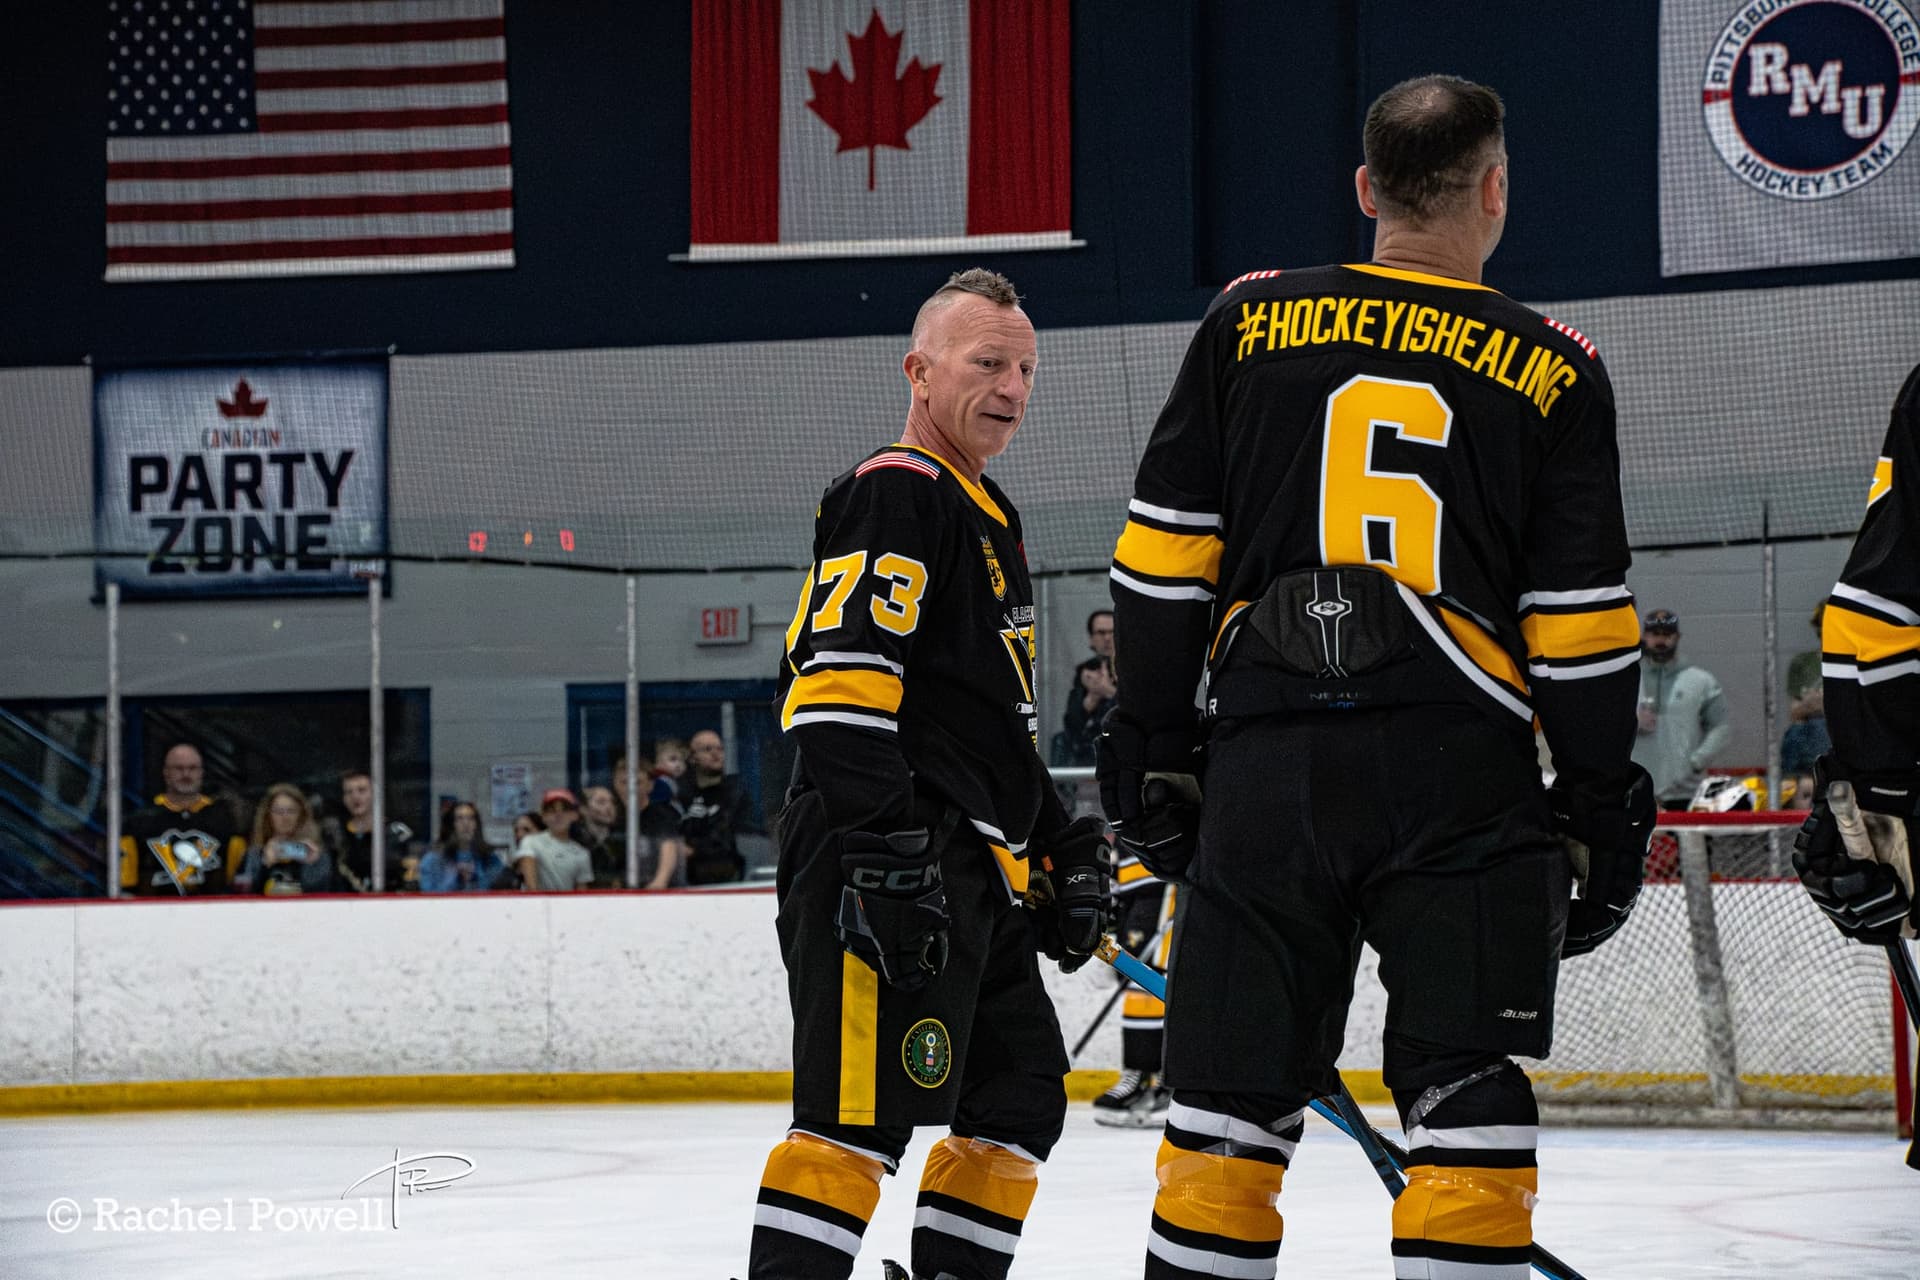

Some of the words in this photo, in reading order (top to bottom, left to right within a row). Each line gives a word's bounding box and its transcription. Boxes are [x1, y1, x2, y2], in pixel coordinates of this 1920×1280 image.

[1860, 0, 1920, 68] OLLEGE
[1748, 41, 1887, 139] RMU
[1736, 153, 1828, 196] HOCKEY
[1828, 142, 1894, 190] TEAM
[1236, 297, 1578, 418] #HOCKEYISHEALING
[201, 427, 282, 450] CANADIAN
[129, 449, 355, 512] PARTY
[1319, 374, 1453, 597] 6
[148, 513, 332, 574] ZONE
[701, 607, 740, 640] EXIT
[811, 550, 929, 637] 73
[853, 860, 943, 891] CCM
[1496, 1008, 1538, 1021] AUER
